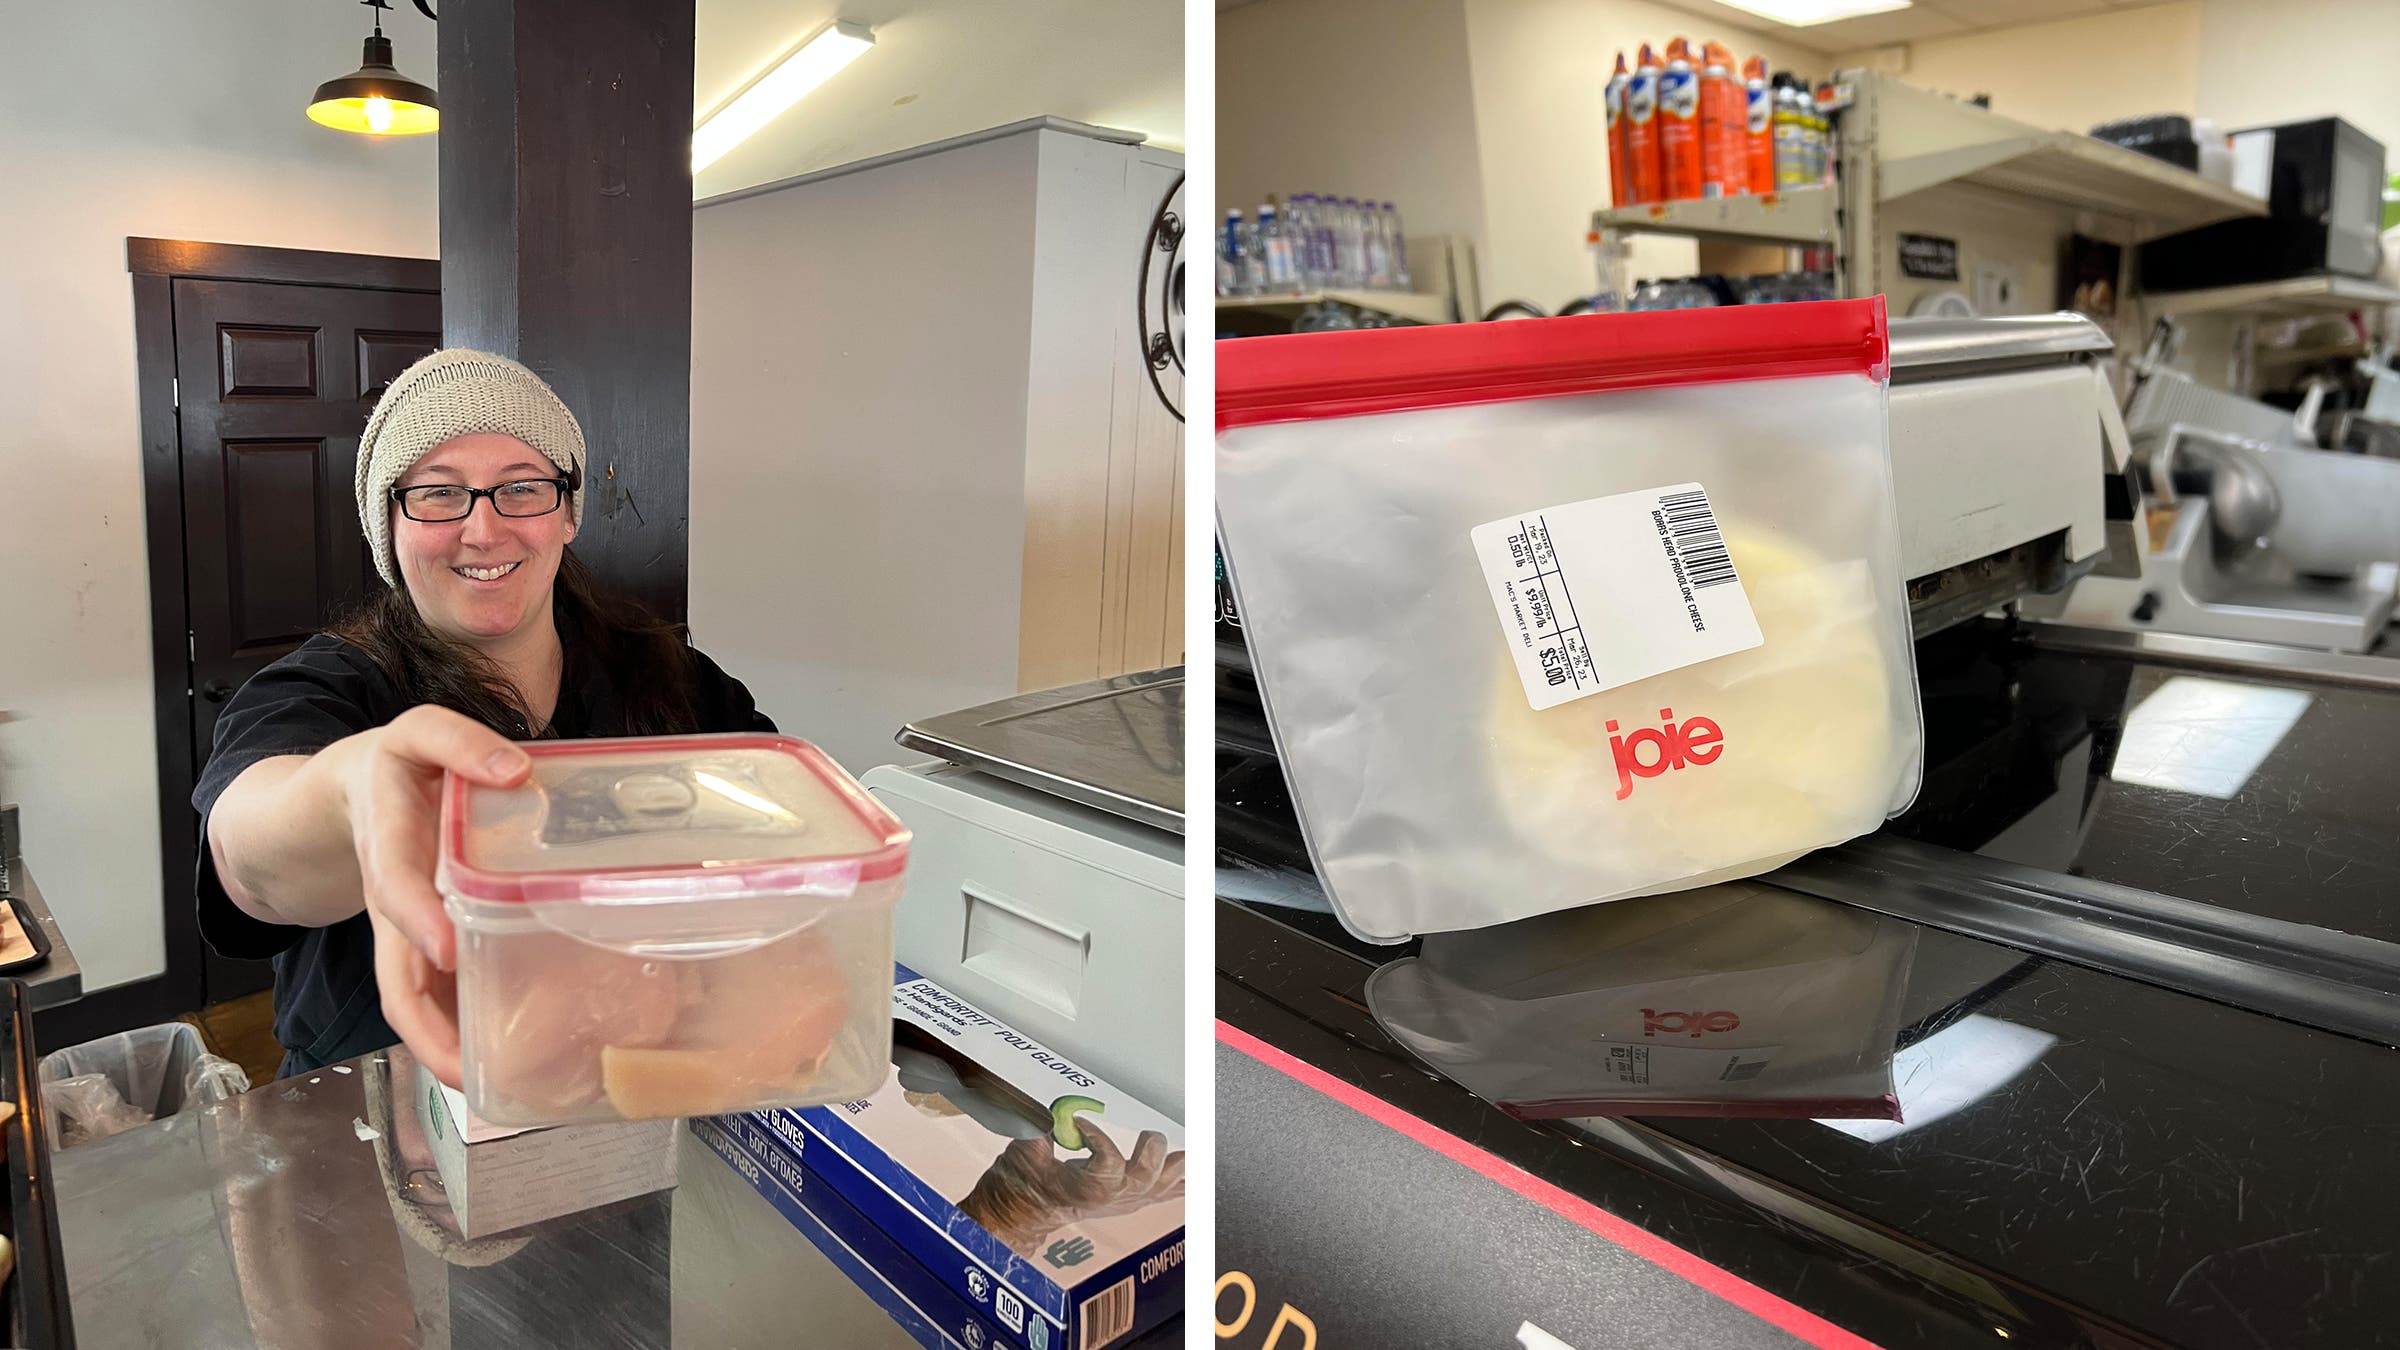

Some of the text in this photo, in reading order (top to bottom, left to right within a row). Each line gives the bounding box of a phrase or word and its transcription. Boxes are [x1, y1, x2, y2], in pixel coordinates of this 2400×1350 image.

[1507, 535, 1526, 568] 0.50 lb
[1528, 526, 1538, 540] Mar
[1538, 553, 1548, 565] 23
[1652, 510, 1668, 536] BOARS
[1662, 537, 1677, 556] HEAD
[1670, 558, 1694, 603] PROVOLONE
[1687, 603, 1705, 632] CHEESE
[1505, 581, 1533, 648] MAC'S MARKET DELI
[1525, 588, 1546, 628] $9.99/lb
[1539, 647, 1567, 686] $5.00
[1567, 638, 1576, 653] Mar
[1577, 669, 1588, 680] 23
[1605, 708, 1724, 800] joie
[994, 1030, 1037, 1051] POLY
[1031, 1051, 1095, 1088] GLOVES
[771, 1109, 804, 1150] GLOVES
[1001, 1294, 1020, 1321] 100
